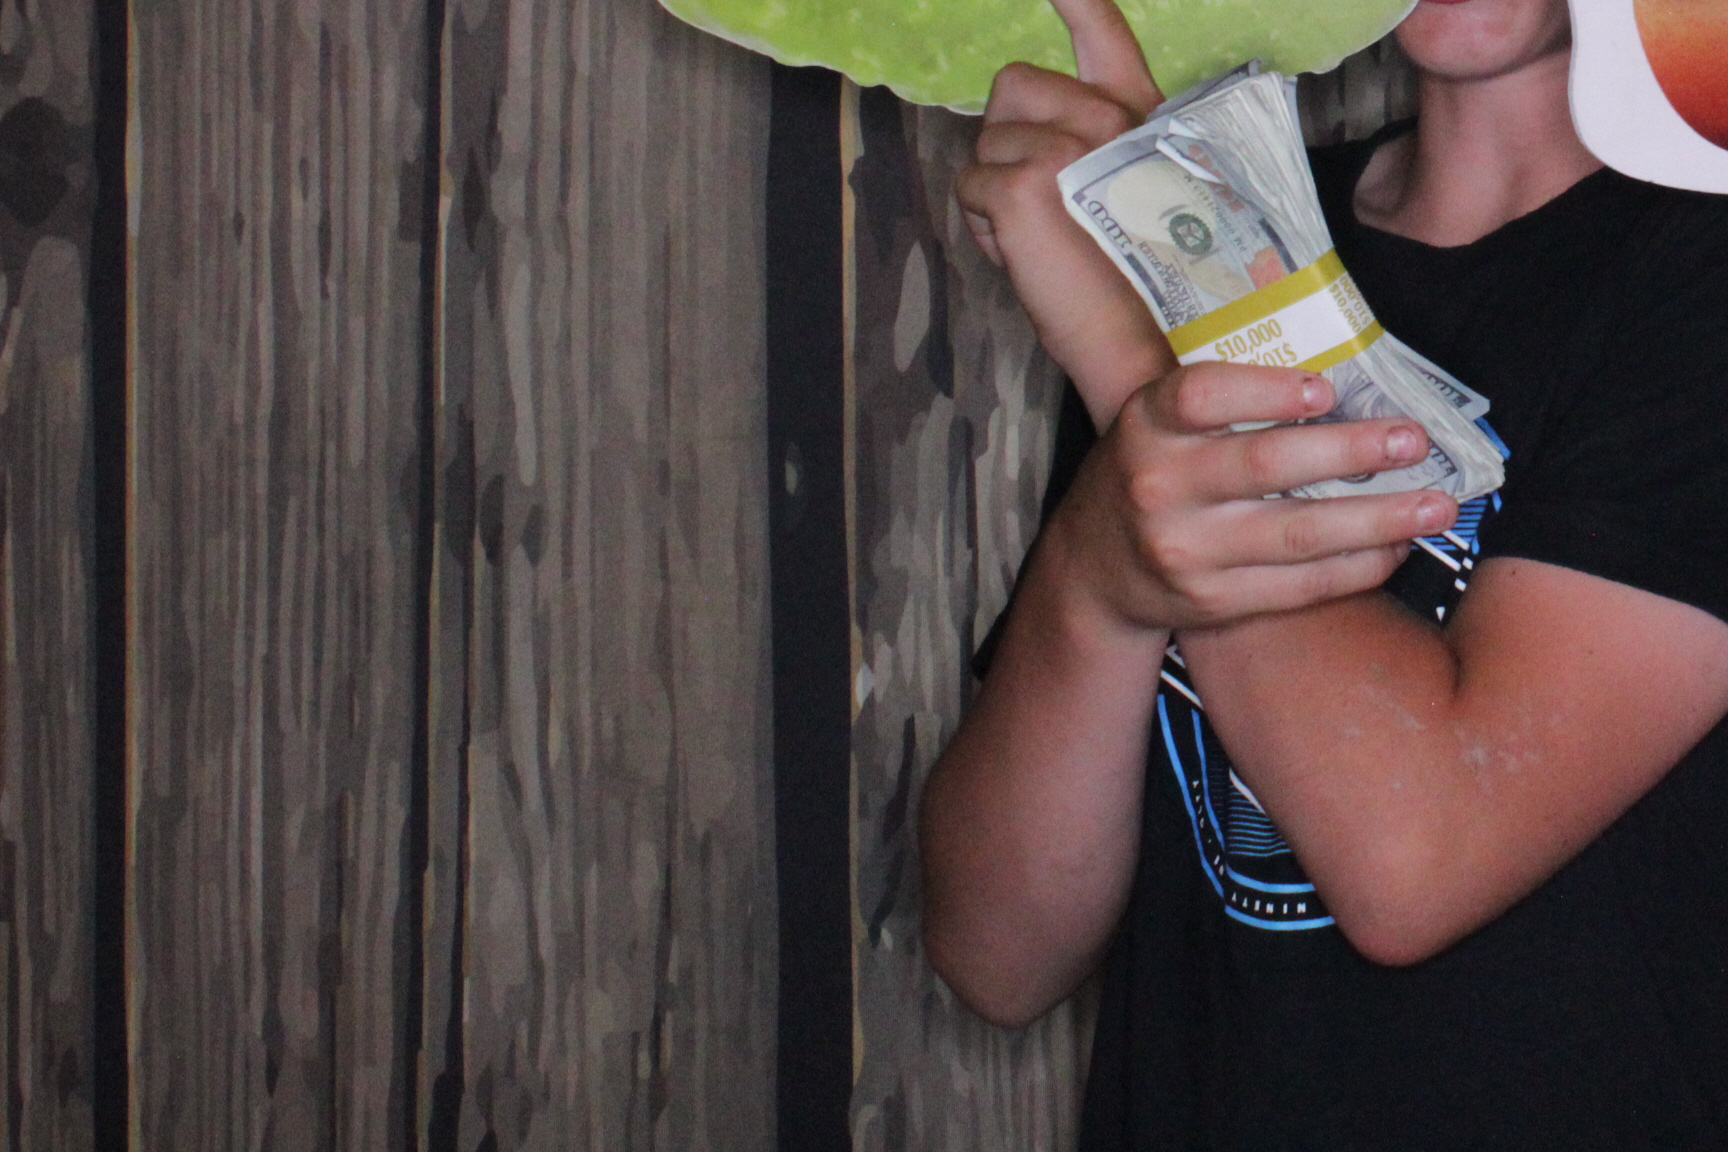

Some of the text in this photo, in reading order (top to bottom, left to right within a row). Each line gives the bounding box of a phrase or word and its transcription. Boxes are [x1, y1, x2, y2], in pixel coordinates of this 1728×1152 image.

[1087, 200, 1132, 249] 100
[1328, 283, 1362, 333] $10,000
[1215, 318, 1283, 363] $10,000
[1231, 892, 1307, 915] NINETY
